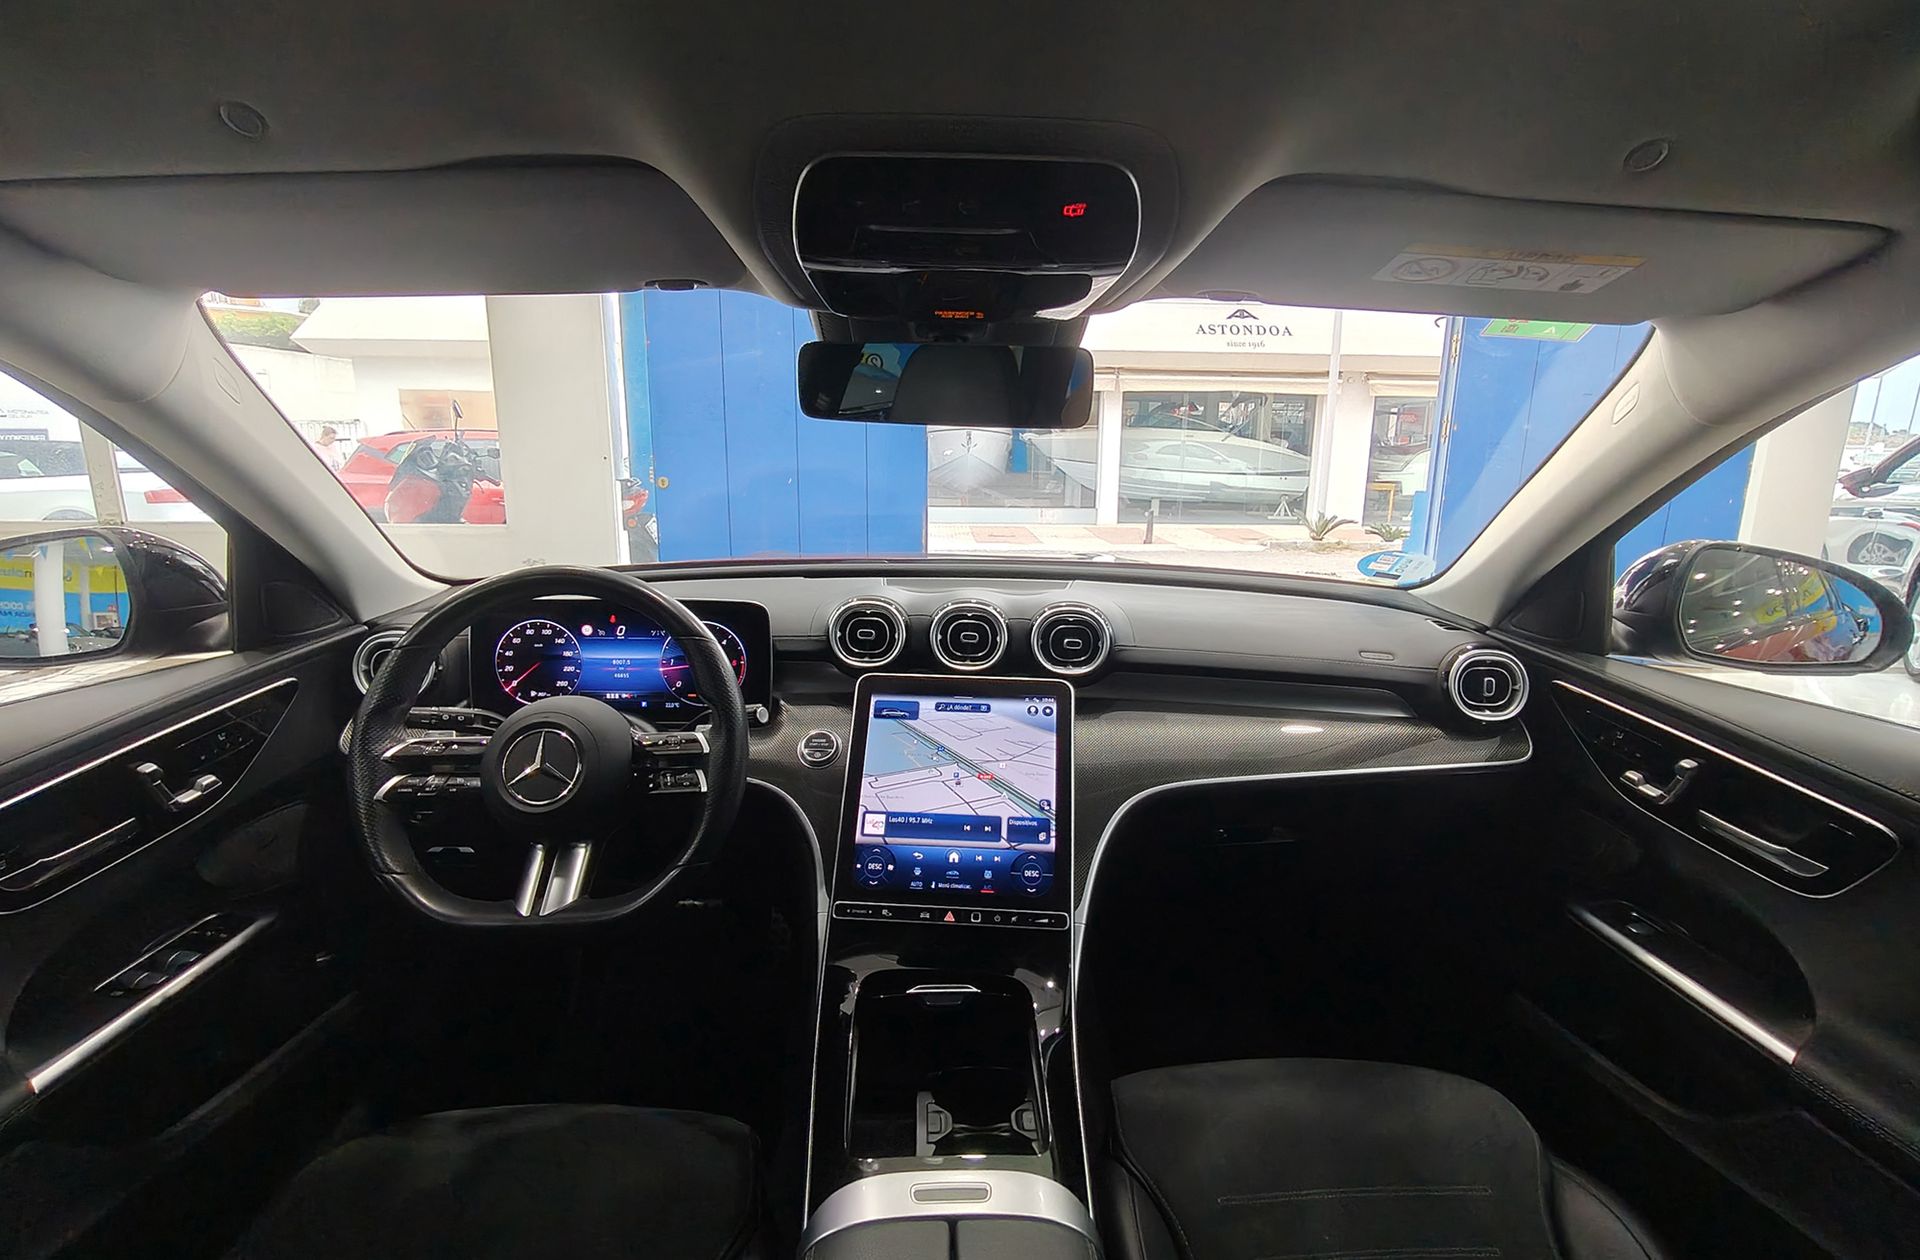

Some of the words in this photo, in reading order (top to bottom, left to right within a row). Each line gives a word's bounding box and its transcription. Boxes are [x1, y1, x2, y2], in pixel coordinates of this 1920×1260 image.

[1195, 323, 1294, 337] ASTONDOA
[1226, 340, 1246, 348] since
[1248, 340, 1266, 350] 1916
[616, 625, 626, 636] 0
[675, 680, 682, 688] 0
[908, 816, 921, 824] 95.7
[867, 862, 883, 870] DESC
[1023, 870, 1040, 878] DESC
